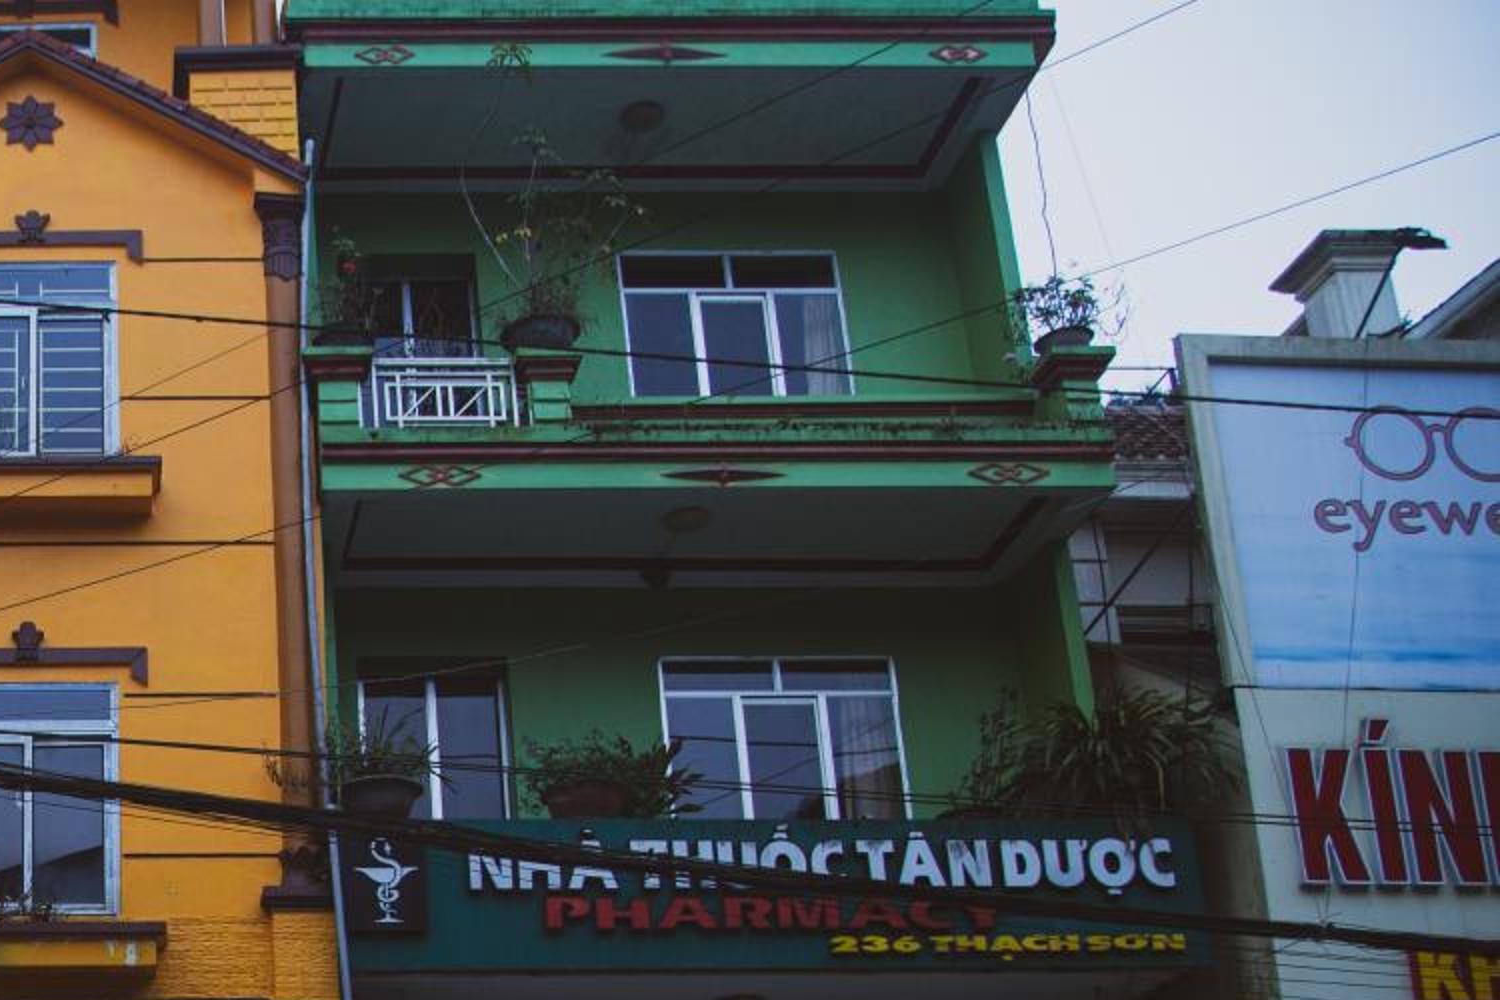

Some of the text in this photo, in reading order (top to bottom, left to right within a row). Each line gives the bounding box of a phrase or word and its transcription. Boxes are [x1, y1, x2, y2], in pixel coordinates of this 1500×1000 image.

[856, 831, 993, 887] TÂN
[1001, 837, 1176, 895] DƯỢC
[545, 893, 998, 931] PHARMACY
[830, 934, 922, 954] 236
[928, 934, 1080, 961] THẠCH
